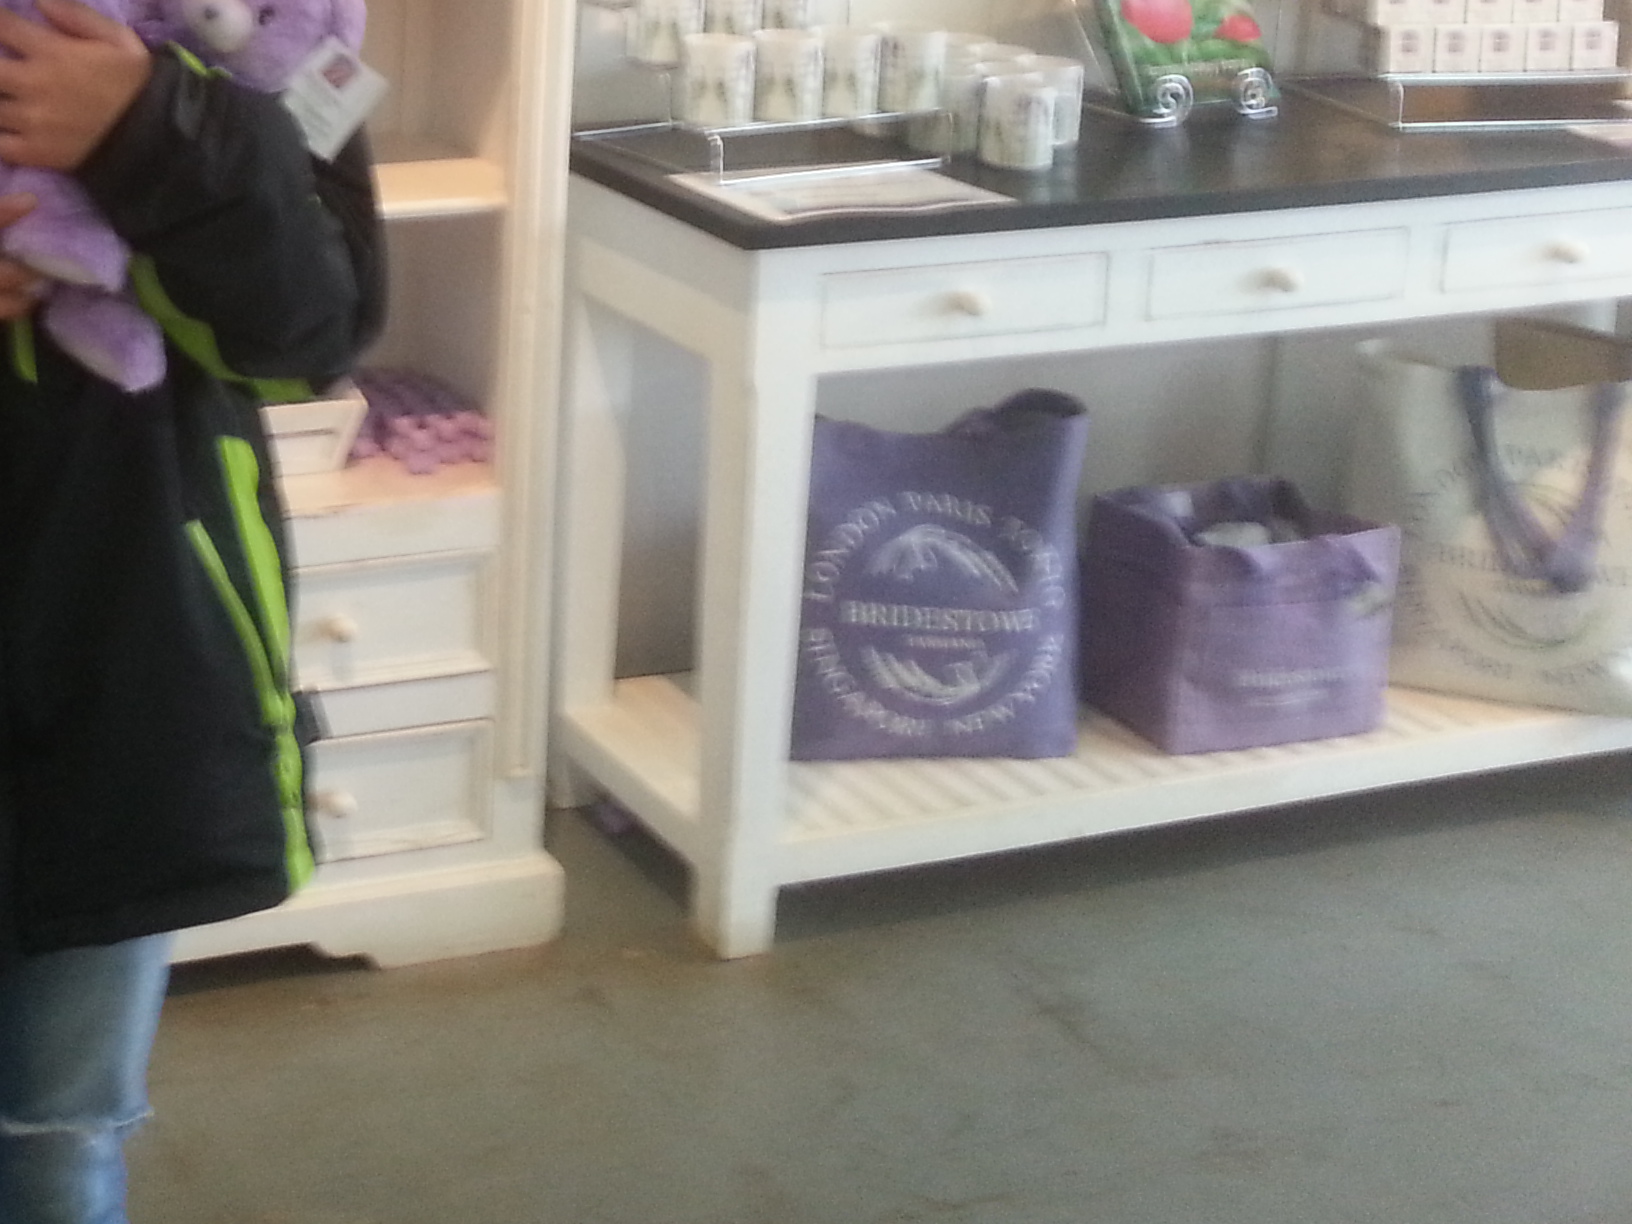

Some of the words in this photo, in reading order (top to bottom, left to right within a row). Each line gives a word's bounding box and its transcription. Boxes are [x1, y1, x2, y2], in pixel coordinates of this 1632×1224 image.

[801, 497, 897, 603] LONDON
[898, 489, 993, 527] PARIS
[838, 599, 1042, 634] BRIDESTOWE
